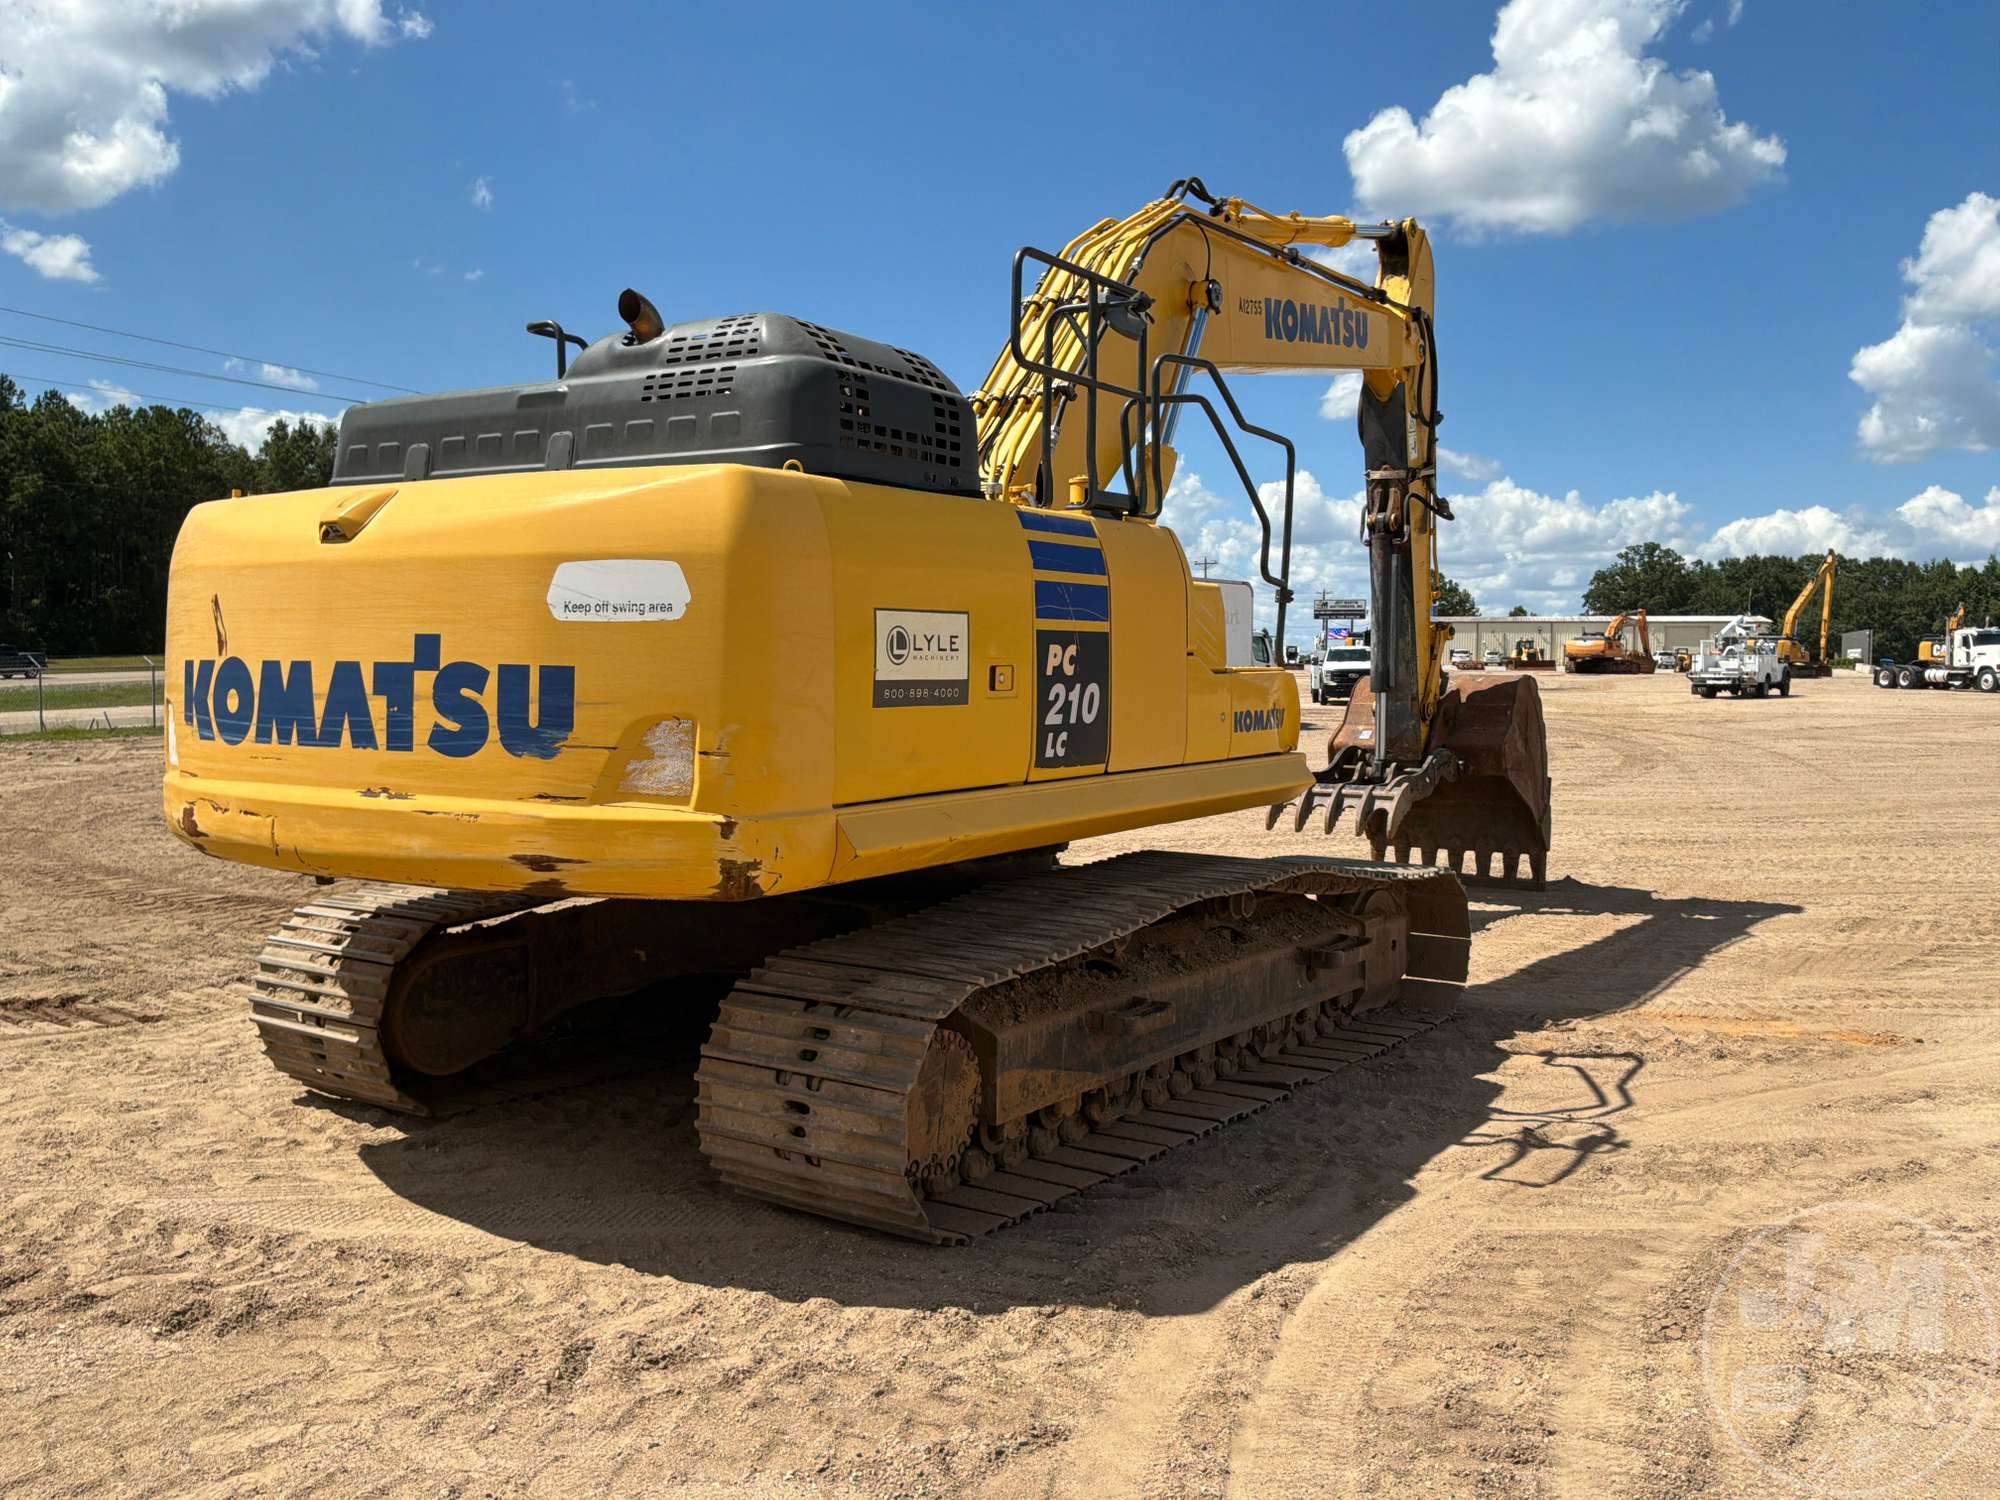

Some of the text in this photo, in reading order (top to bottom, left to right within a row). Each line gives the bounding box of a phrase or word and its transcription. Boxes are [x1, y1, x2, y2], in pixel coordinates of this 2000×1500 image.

[1264, 296, 1368, 349] KOMATSU
[563, 600, 673, 616] Keep off swing area
[913, 634, 959, 652] LYLE
[1045, 644, 1079, 676] PC
[185, 634, 575, 760] KOMATSU
[883, 688, 960, 699] 800-898-4000
[1044, 682, 1101, 726] 210
[1045, 731, 1068, 759] LC
